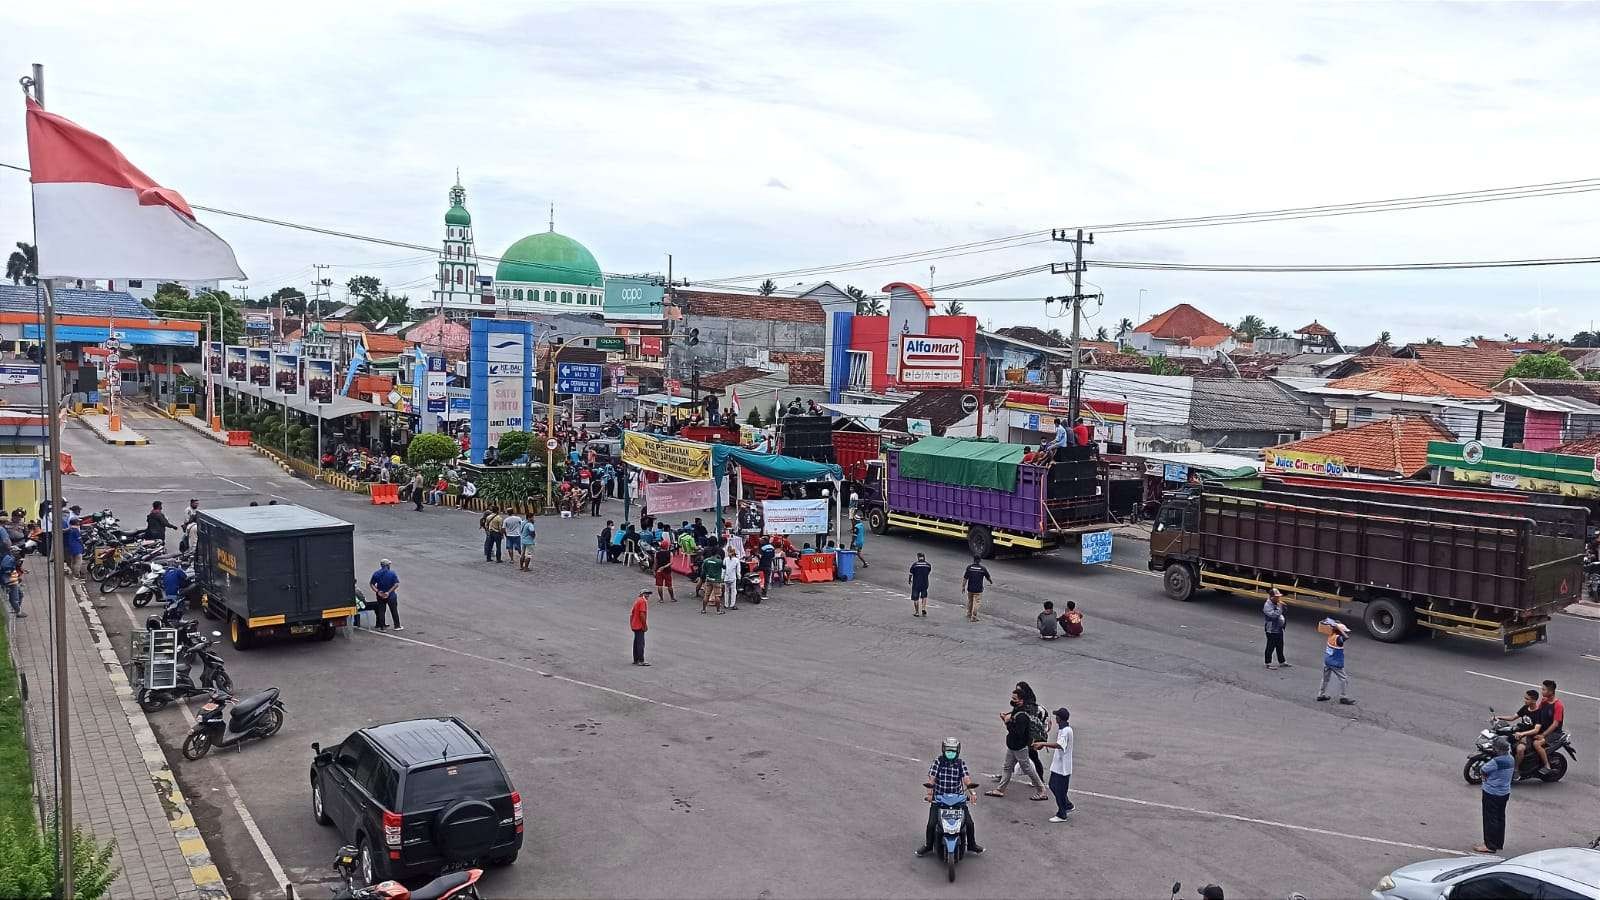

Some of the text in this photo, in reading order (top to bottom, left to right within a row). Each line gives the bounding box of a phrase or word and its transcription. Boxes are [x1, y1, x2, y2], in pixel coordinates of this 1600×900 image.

[621, 287, 643, 303] oppo
[906, 340, 960, 354] Alfamart
[506, 417, 522, 426] LCM
[1275, 456, 1294, 468] Juice
[1326, 462, 1341, 474] Duo
